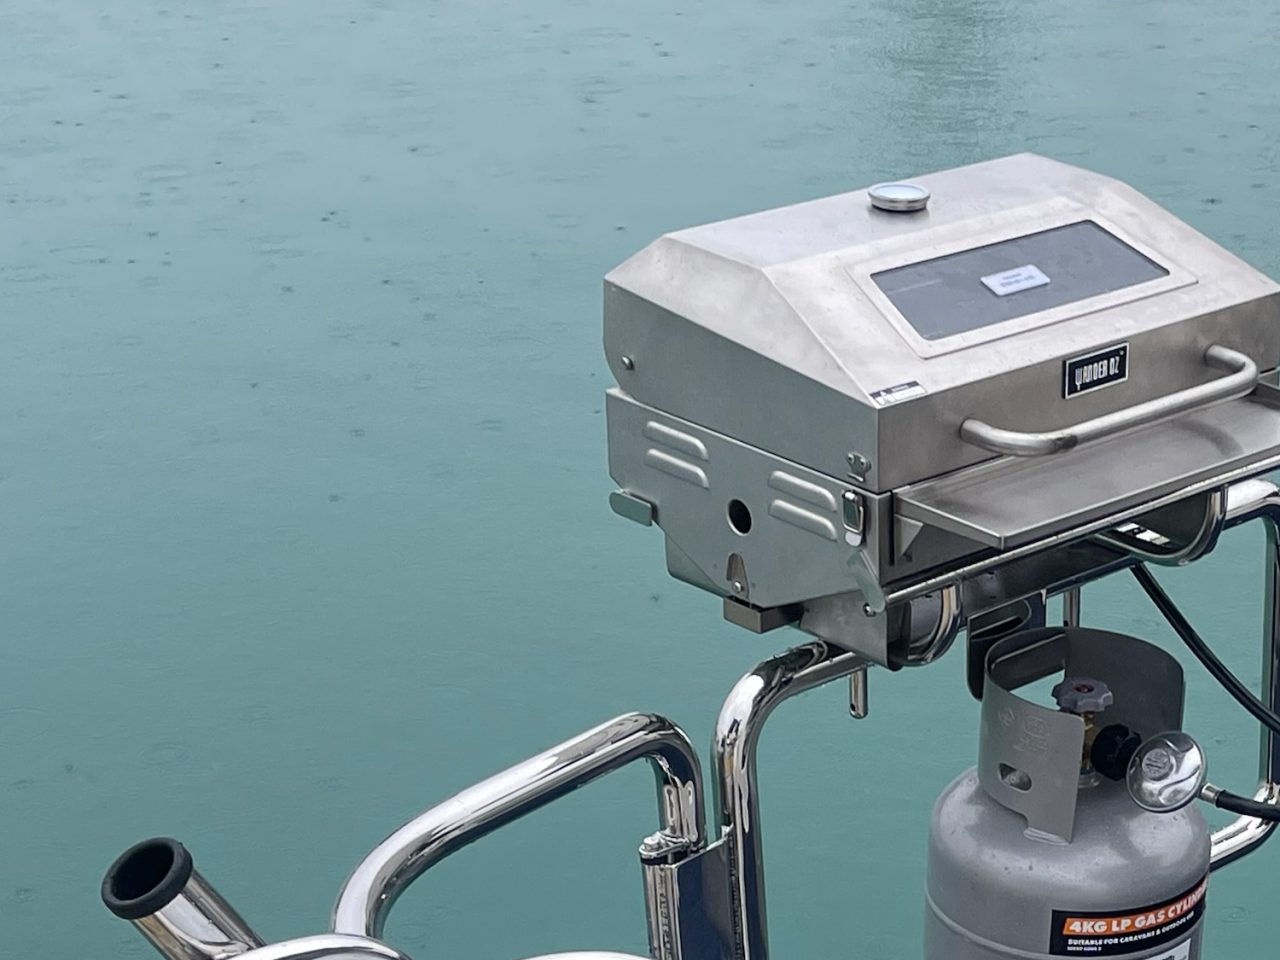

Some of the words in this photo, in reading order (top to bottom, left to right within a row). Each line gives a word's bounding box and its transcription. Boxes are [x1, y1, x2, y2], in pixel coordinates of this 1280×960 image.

[1069, 920, 1107, 933] 4KG
[1111, 918, 1132, 932] LP
[1135, 909, 1165, 928] GAS
[1067, 938, 1102, 946] SUITABLE
[1103, 937, 1119, 945] FOR
[1119, 930, 1156, 944] CARAVANS
